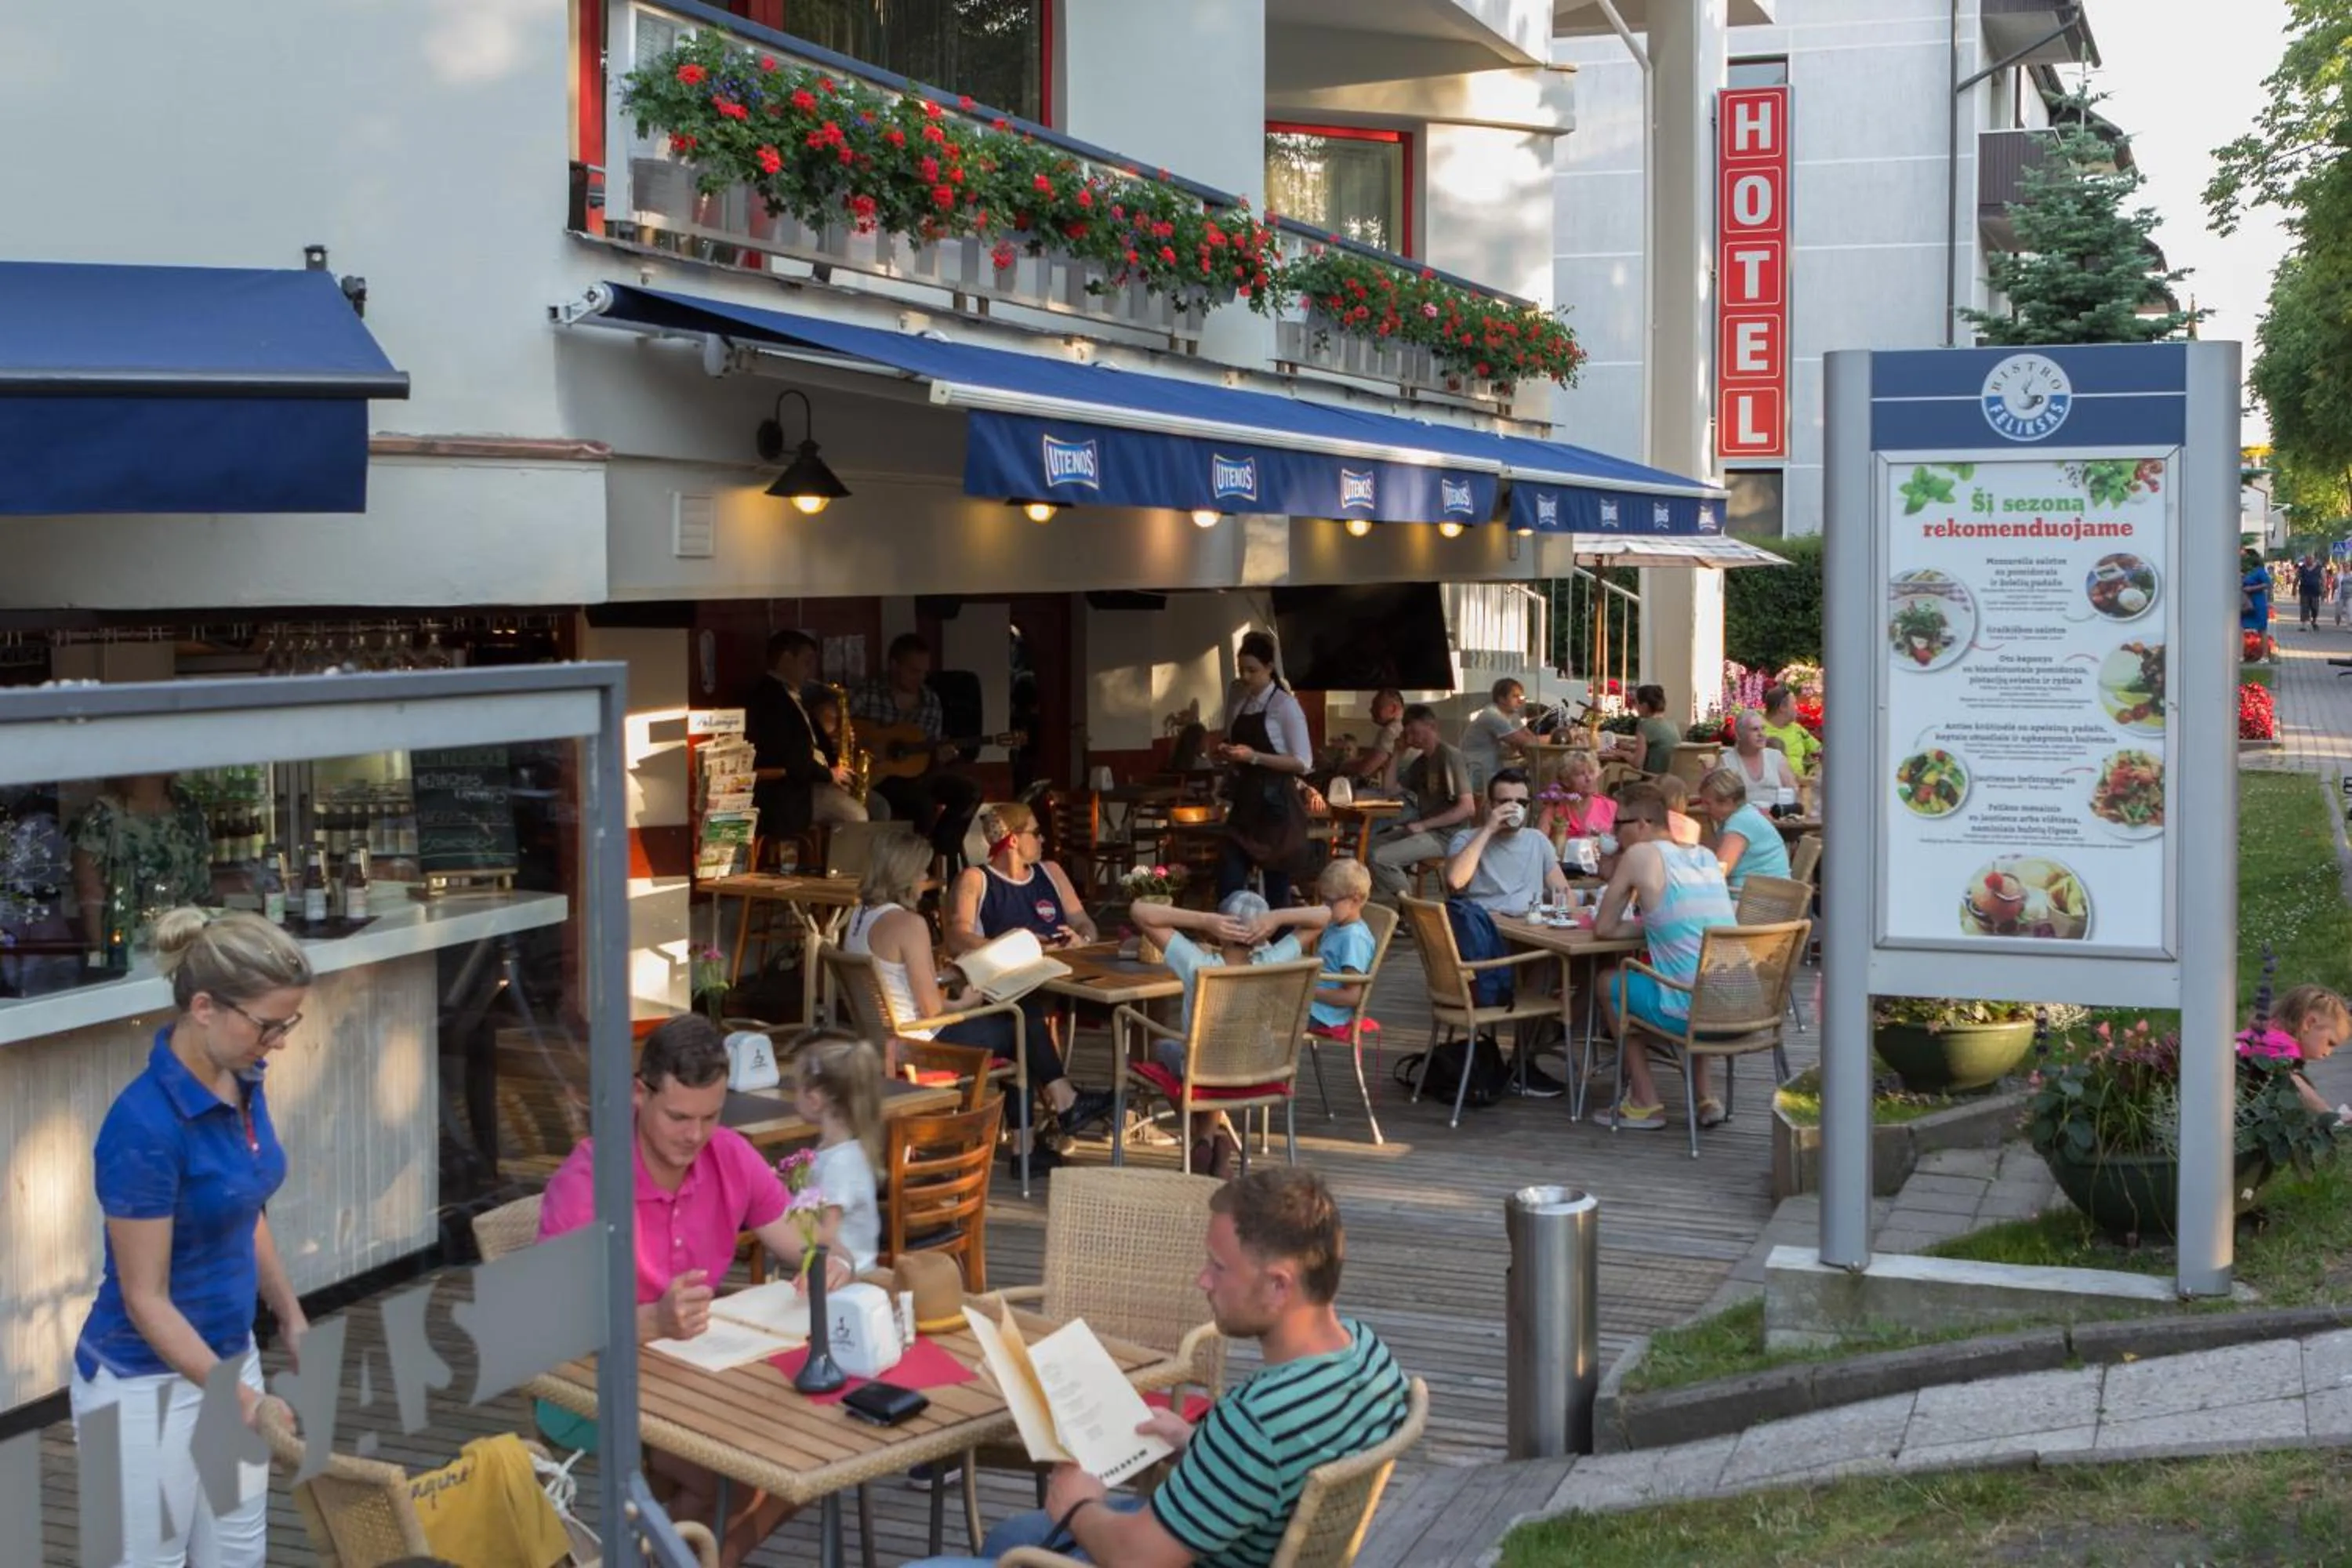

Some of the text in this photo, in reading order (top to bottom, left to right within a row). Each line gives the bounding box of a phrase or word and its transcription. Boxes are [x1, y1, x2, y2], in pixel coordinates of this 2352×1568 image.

[1733, 102, 1773, 445] HOTEL
[1991, 361, 2063, 391] BISTRO
[1990, 403, 2063, 434] FELIKSAS
[1048, 445, 1095, 477] UTENOS
[1216, 464, 1253, 490] UTENOS
[1971, 488, 2085, 517] Šį sezoną
[1923, 517, 2133, 541] rekomenduojame
